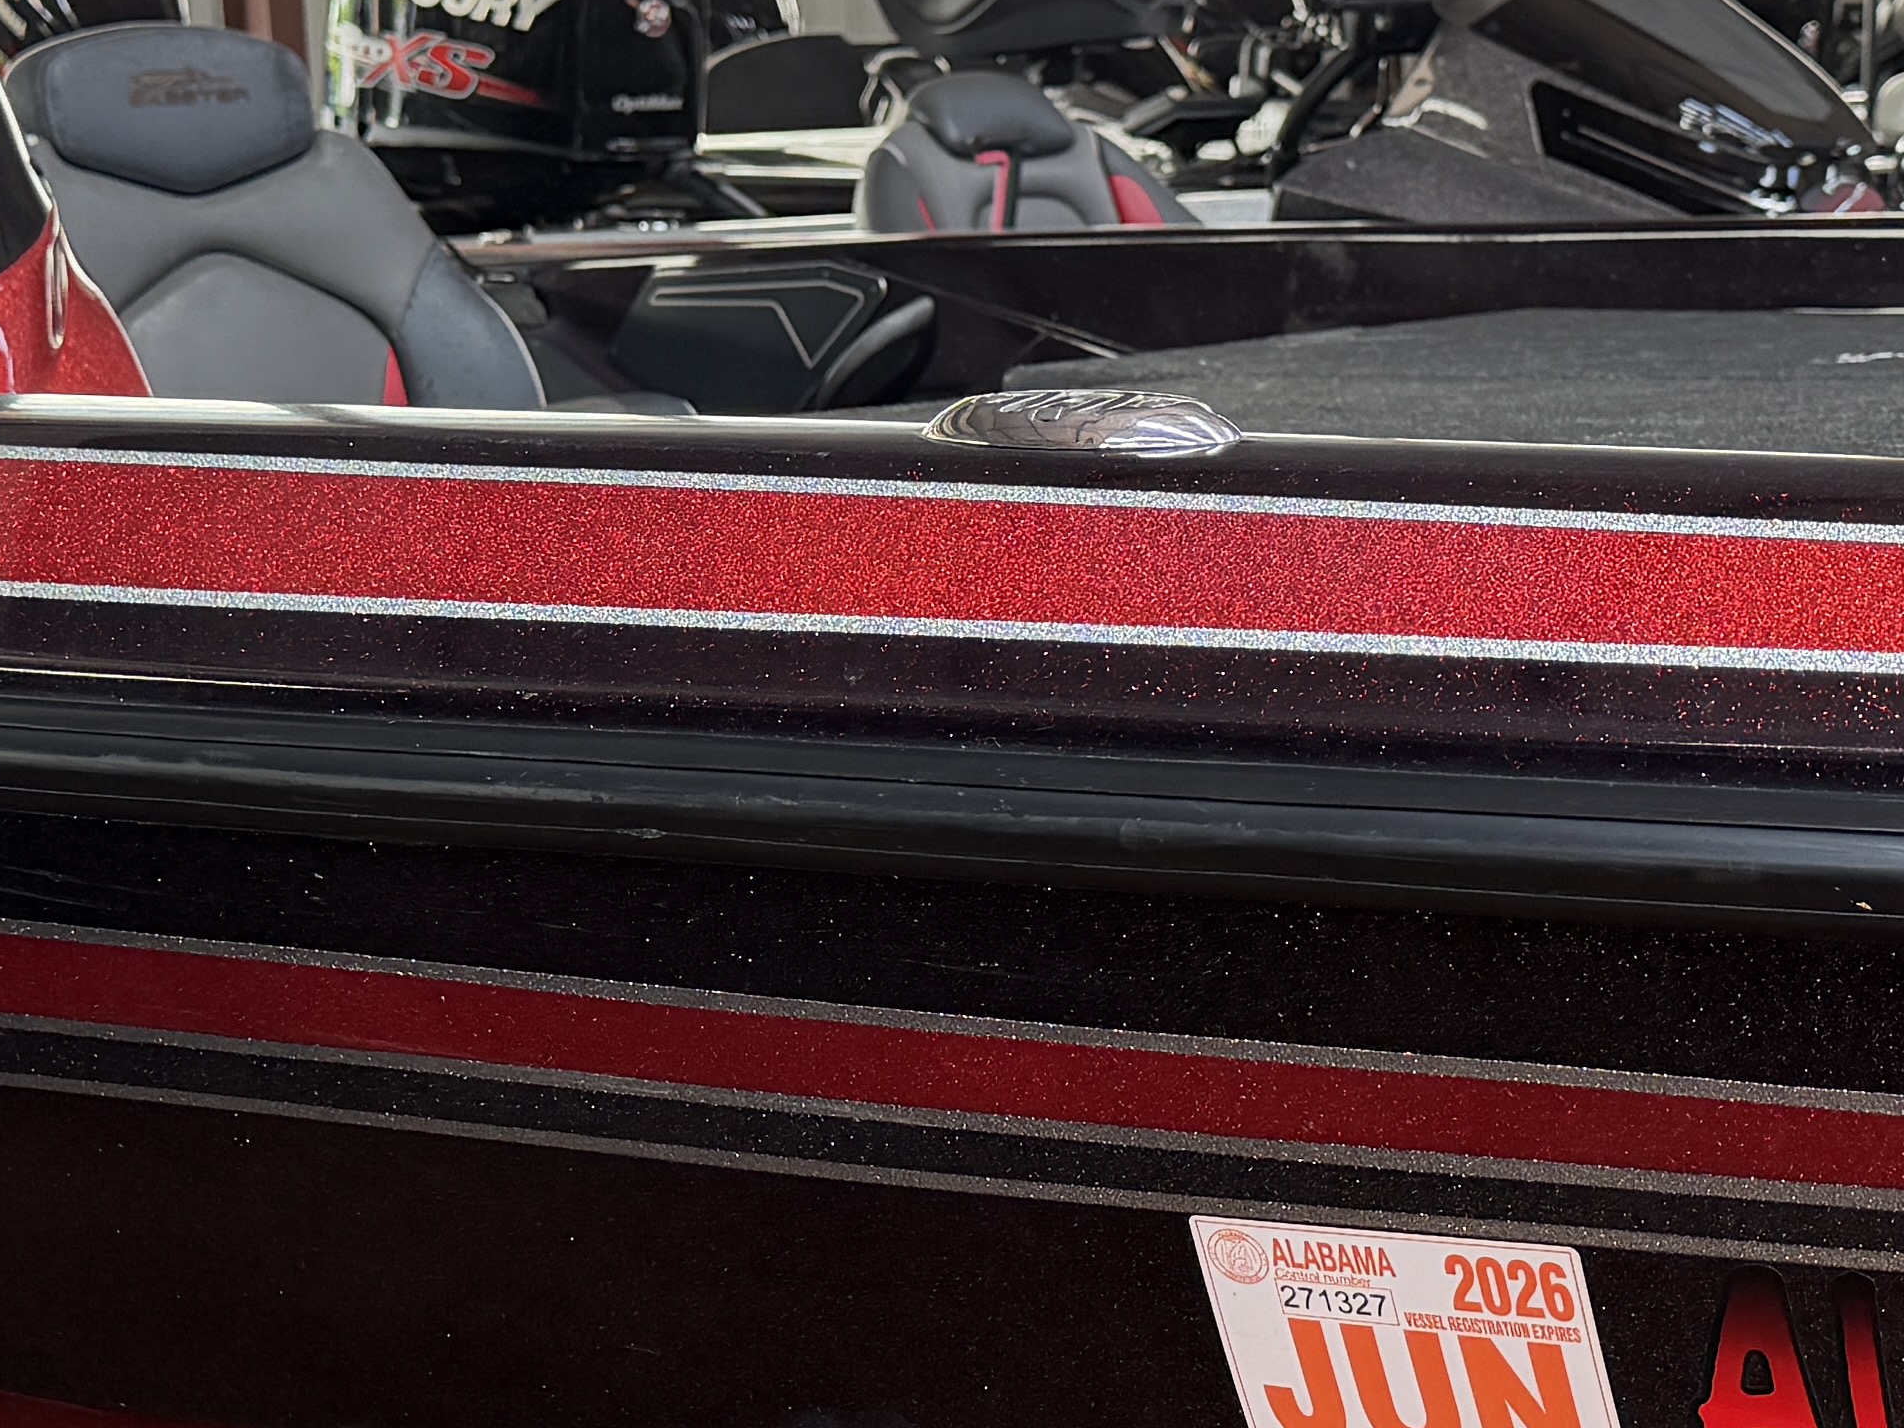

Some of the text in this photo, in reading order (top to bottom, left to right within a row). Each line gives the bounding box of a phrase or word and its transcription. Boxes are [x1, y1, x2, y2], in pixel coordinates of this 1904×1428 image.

[1272, 1238, 1397, 1278] ALABAMA
[1444, 1254, 1575, 1322] 2026
[1323, 1273, 1372, 1288] number
[1280, 1285, 1387, 1317] 271327
[1403, 1311, 1582, 1344] VESSEL REGISTRATION EXPIRES
